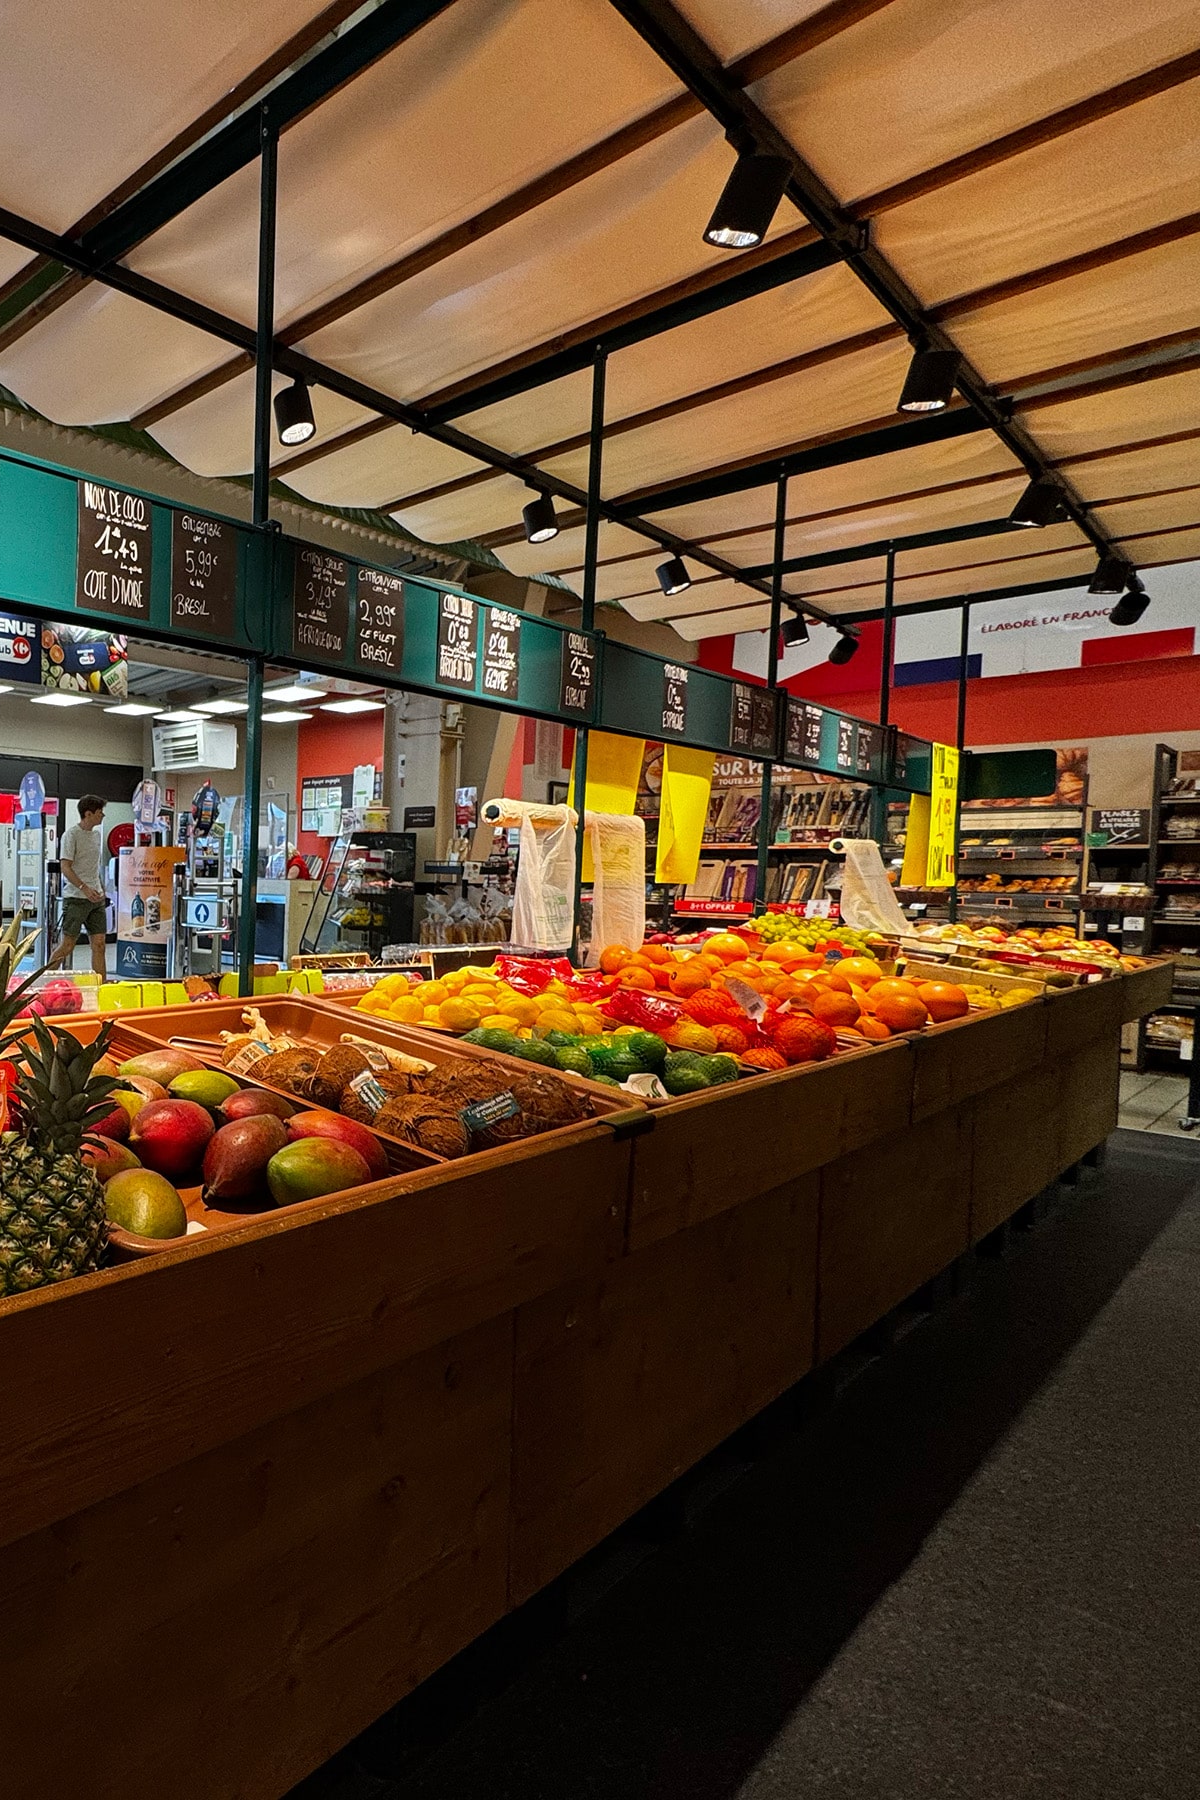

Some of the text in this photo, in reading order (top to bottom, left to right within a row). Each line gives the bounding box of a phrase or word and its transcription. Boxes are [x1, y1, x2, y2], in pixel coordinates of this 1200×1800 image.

[84, 482, 107, 514] NOIX
[109, 490, 122, 518] DE
[123, 495, 145, 522] COCO
[981, 617, 1039, 634] ÉLABORÉ
[1042, 616, 1060, 625] EN
[360, 628, 372, 639] LE
[712, 760, 745, 776] SUR
[719, 778, 742, 786] TOUTE
[1100, 810, 1141, 818] PENSEZ
[705, 903, 736, 911] OFFERT
